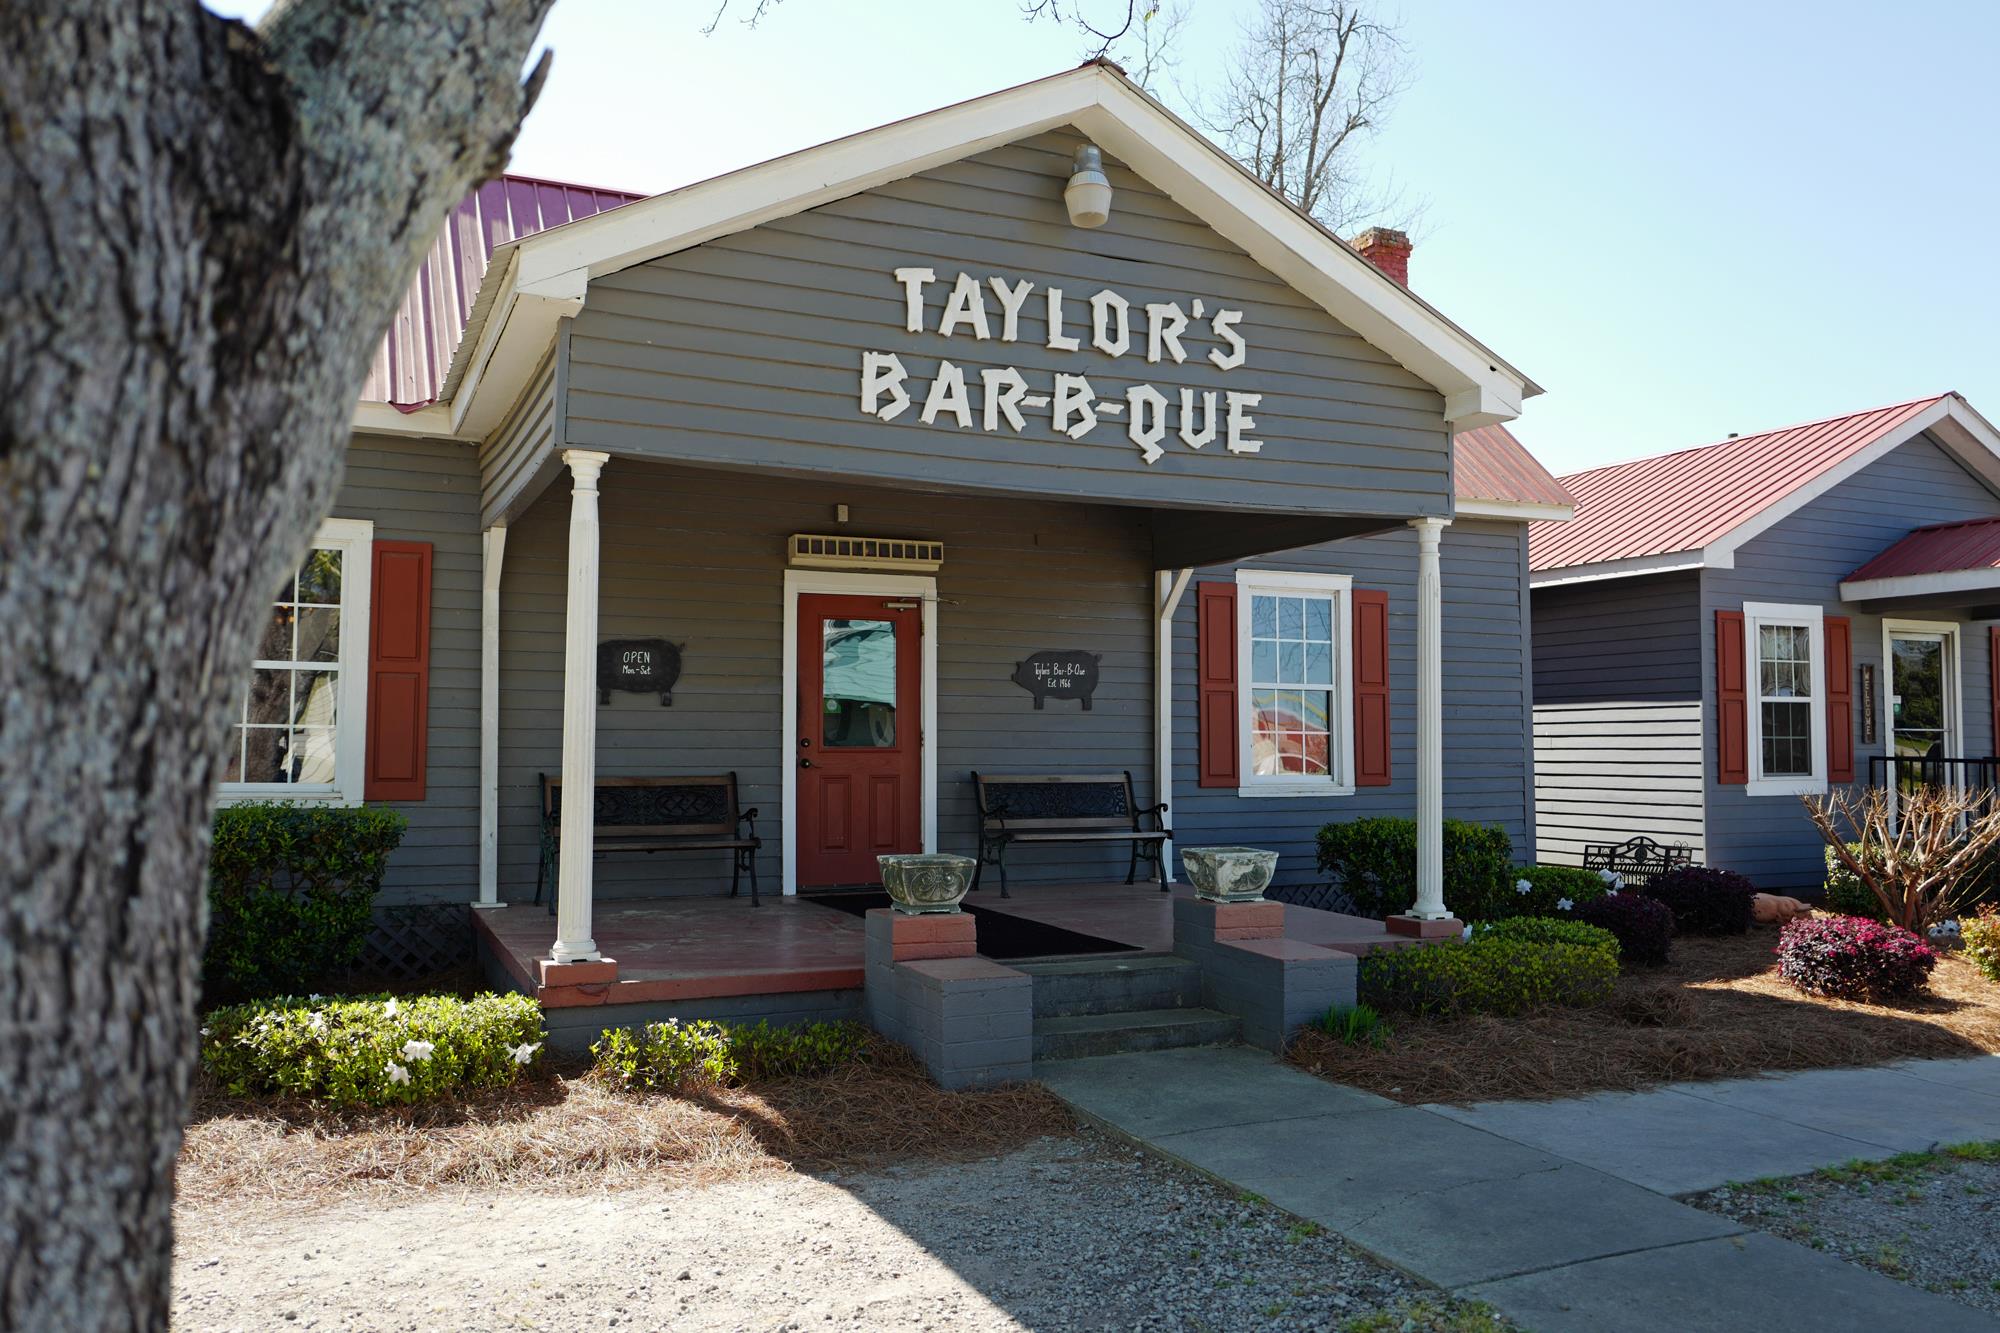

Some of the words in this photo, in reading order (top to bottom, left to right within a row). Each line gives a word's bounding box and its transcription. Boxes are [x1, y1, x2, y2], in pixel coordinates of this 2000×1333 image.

[894, 268, 1245, 370] TAYLOR'S
[861, 351, 1263, 464] BAR-B-QUE
[623, 651, 650, 663] OPEN
[1864, 671, 1872, 735] WELCOME
